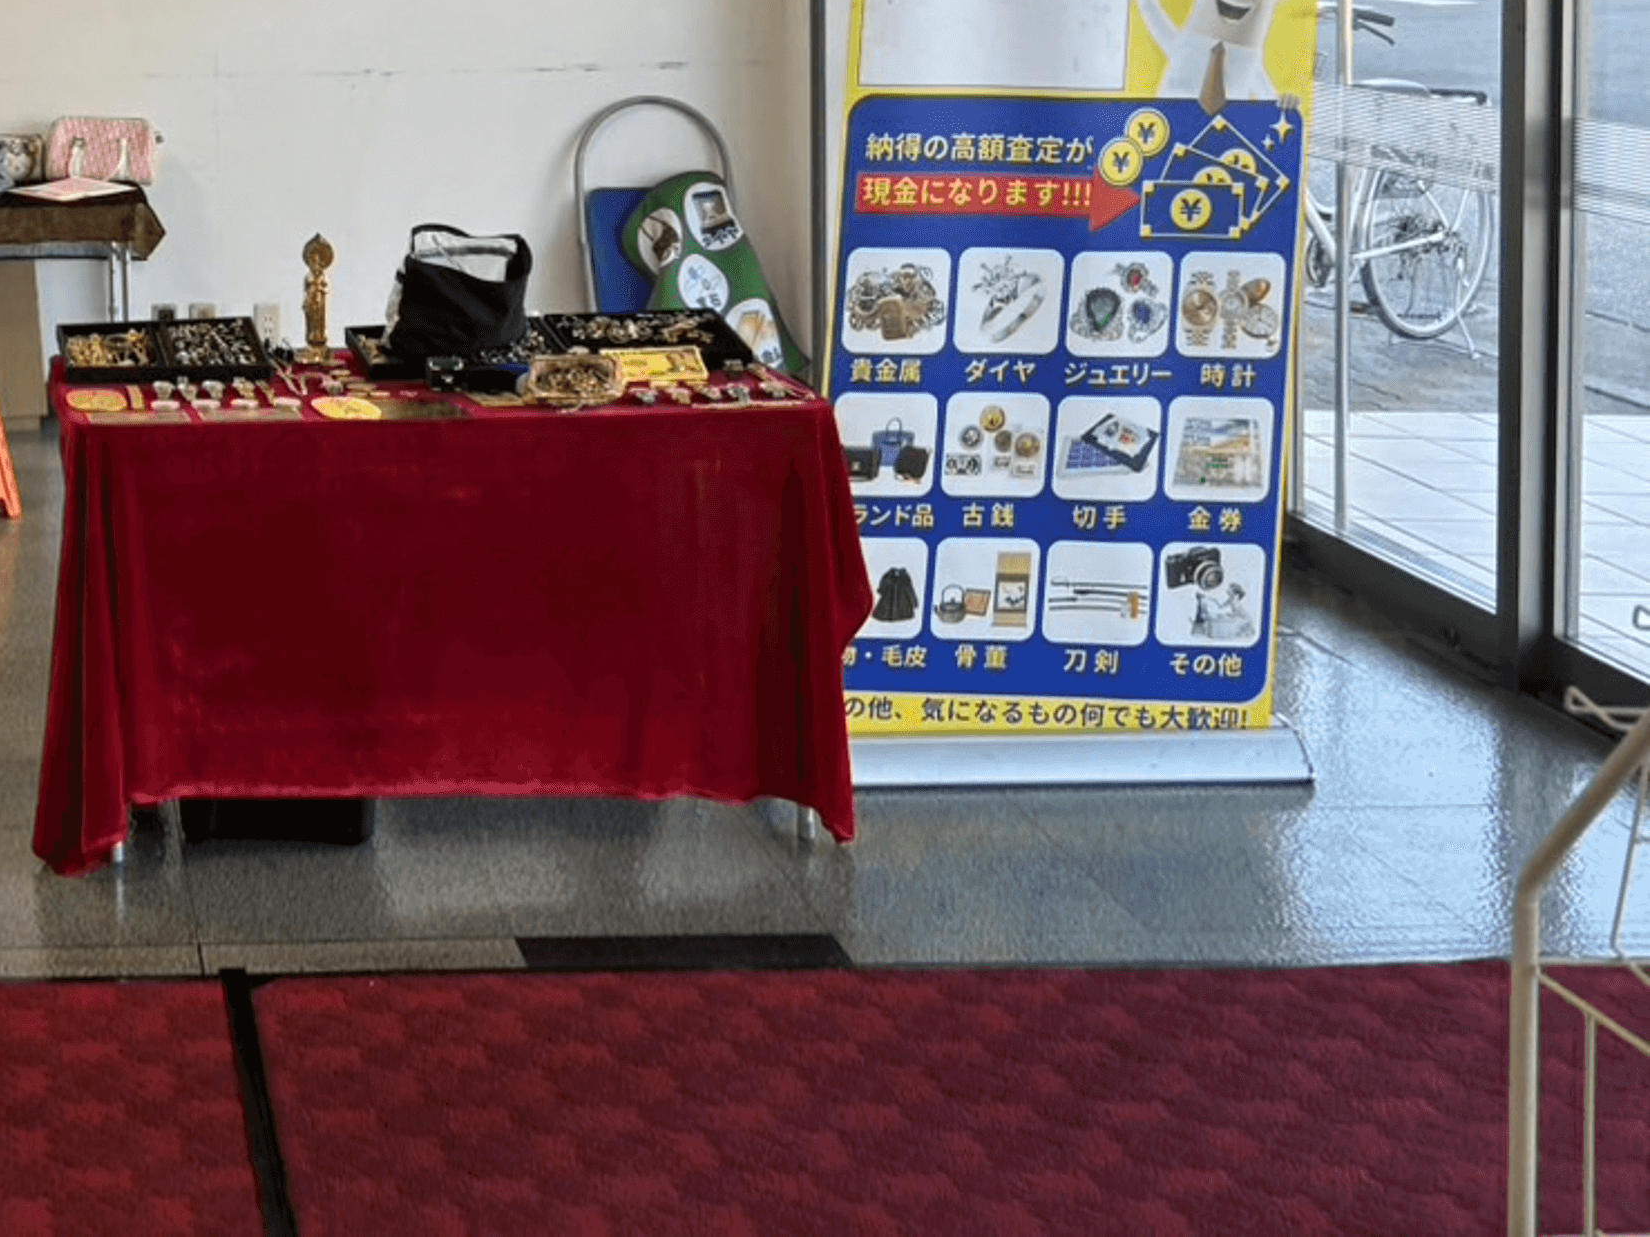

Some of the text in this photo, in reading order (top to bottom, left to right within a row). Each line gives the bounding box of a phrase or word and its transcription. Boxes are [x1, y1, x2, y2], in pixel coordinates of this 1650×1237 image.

[865, 132, 1095, 164] 納得の高額査定が
[862, 176, 1093, 208] 現金になります!!!
[850, 358, 1257, 389] 貴金属 ダイヤ ジュエリー 時計
[961, 502, 1015, 528] 古銭
[1072, 504, 1128, 530] 切手
[1187, 505, 1244, 533] 金券
[1063, 649, 1120, 675] 刀剣
[1169, 653, 1244, 678] その他
